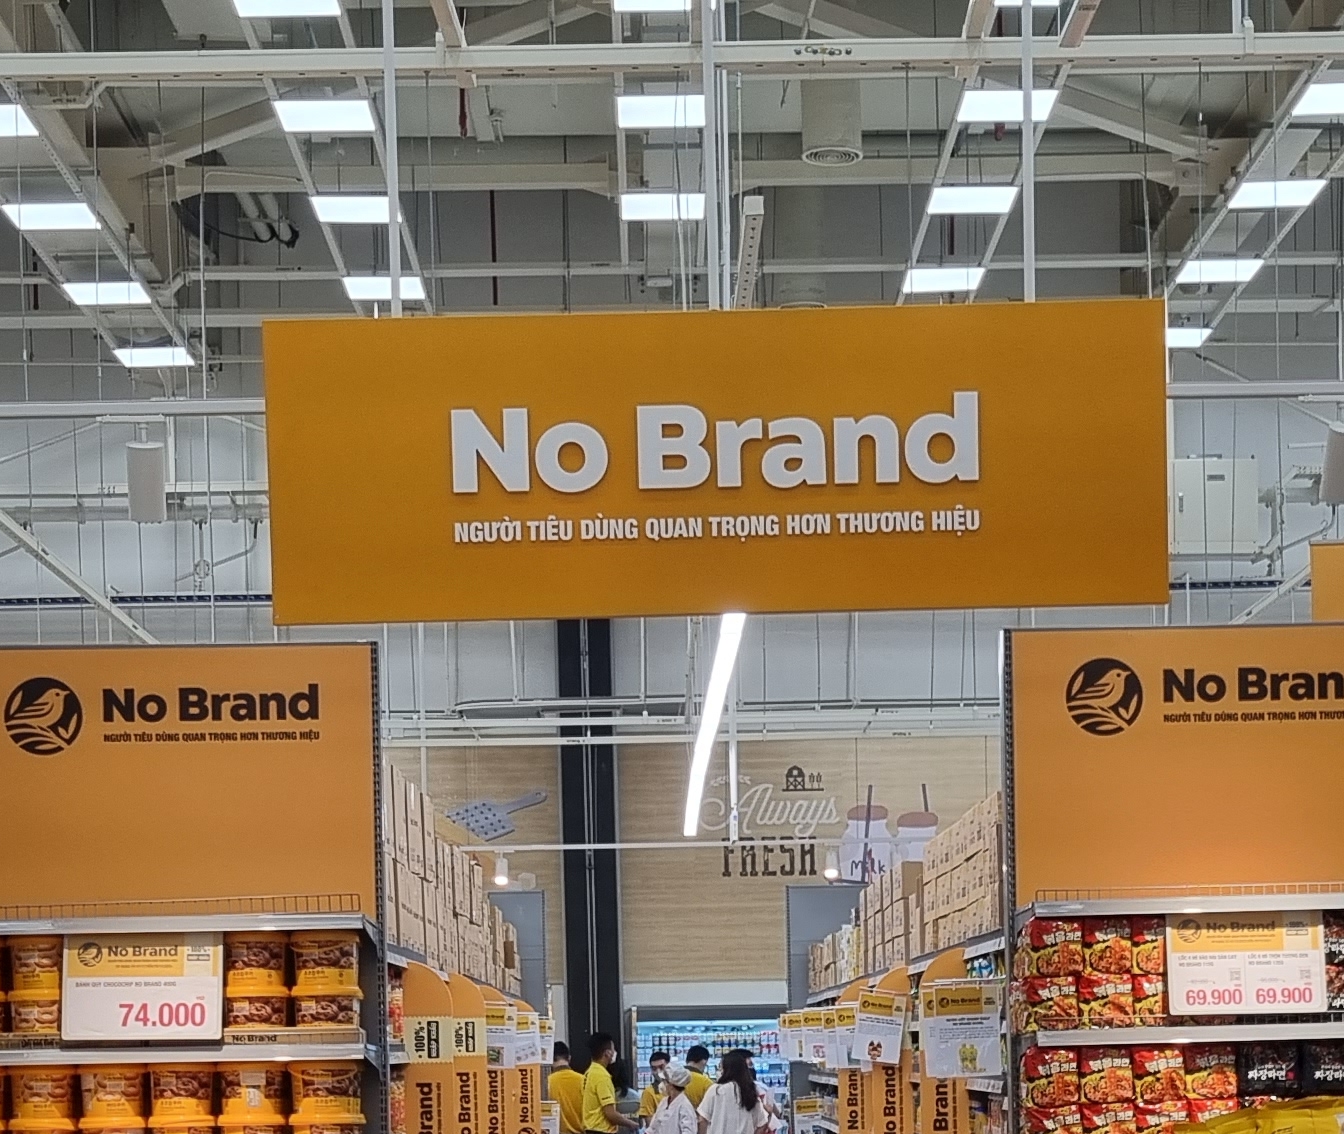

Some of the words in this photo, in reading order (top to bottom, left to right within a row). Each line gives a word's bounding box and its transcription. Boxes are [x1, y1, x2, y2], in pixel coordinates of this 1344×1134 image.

[450, 407, 609, 494] No
[635, 390, 980, 490] Brand
[453, 515, 524, 546] NGƯỜI
[526, 513, 574, 542] TIÊU
[579, 510, 639, 541] DÙNG
[644, 513, 703, 542] QUAN
[708, 511, 780, 543] TRỌNG
[785, 510, 833, 536] HƠN
[836, 506, 925, 535] THƯƠNG
[931, 504, 982, 538] HIỆU
[1163, 668, 1226, 704] No
[102, 688, 167, 723] No
[178, 683, 320, 722] Brand
[1241, 712, 1265, 723] QUAN
[182, 732, 206, 743] QUAN
[721, 836, 817, 877] FRESH
[107, 945, 129, 957] No
[132, 944, 178, 957] Brand
[1185, 988, 1243, 1006] 69.900
[1255, 987, 1313, 1005] 69.900
[119, 1002, 206, 1027] 74.000
[414, 1026, 426, 1053] 100%
[456, 1072, 471, 1123] Brand
[882, 1066, 896, 1117] Brand
